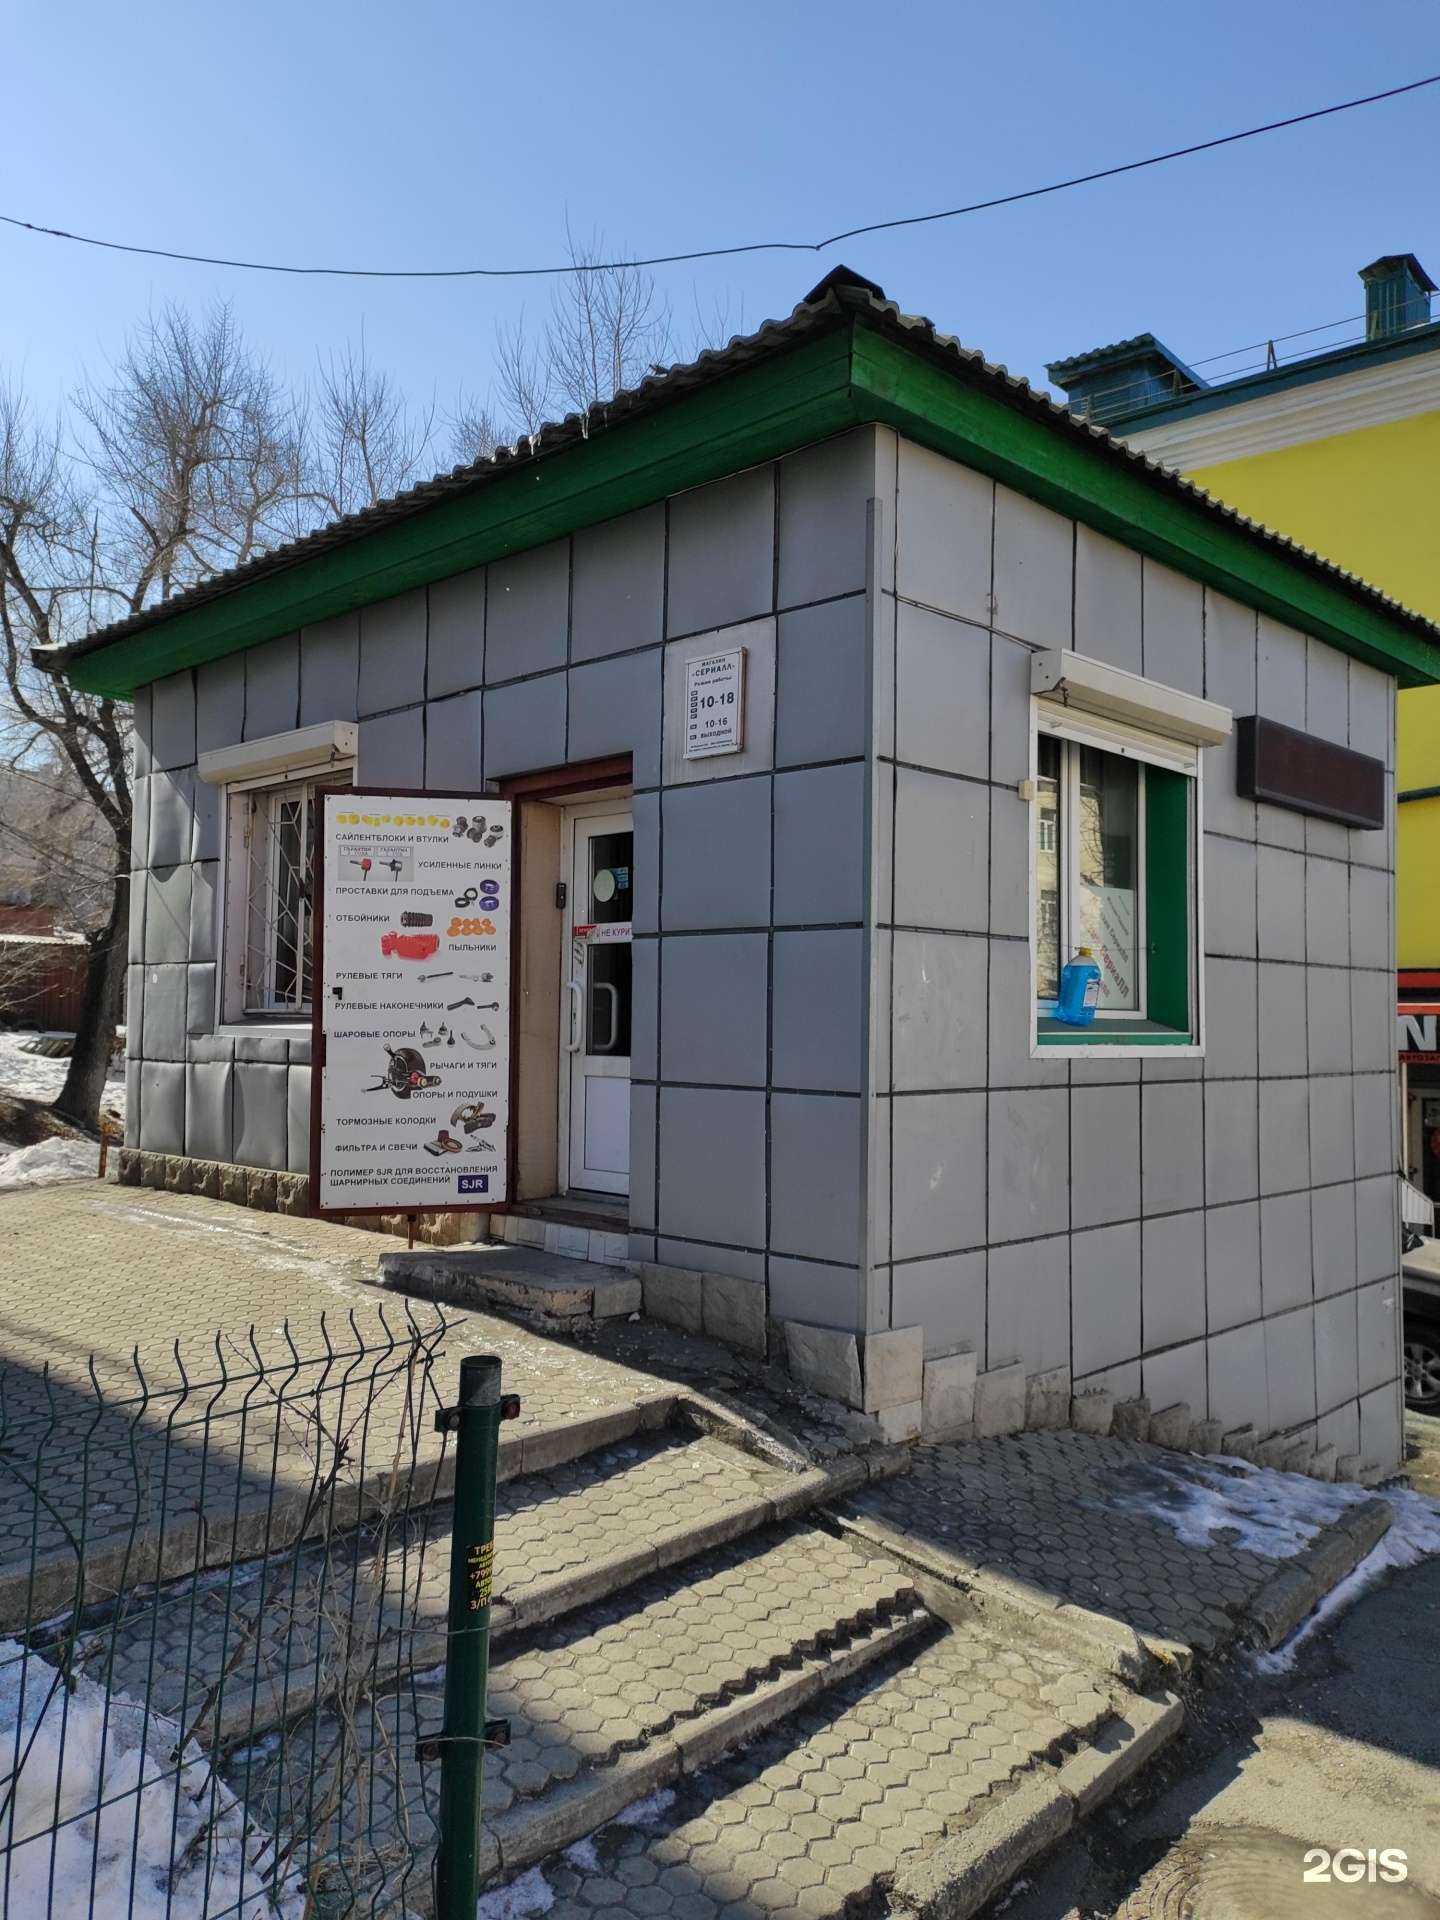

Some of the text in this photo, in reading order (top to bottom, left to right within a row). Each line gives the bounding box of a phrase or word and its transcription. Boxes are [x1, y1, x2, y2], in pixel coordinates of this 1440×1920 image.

[700, 692, 734, 709] 10-18
[336, 833, 406, 842] САЙЛЕНТБЛОКИ
[474, 863, 502, 871] ЛИНКИ
[336, 887, 388, 895] ПРОСТАВКИ
[390, 888, 408, 896] ДЛЯ
[336, 913, 390, 922] ОТБОЙНИКИ
[336, 972, 403, 980] РУЛЕВЫЕ ТЯГИ
[382, 1030, 416, 1038] ОПОРЫ
[429, 1062, 465, 1070] РЫЧАГИ
[456, 1091, 498, 1099] ПОДУШКИ
[336, 1117, 436, 1126] ТОРМОЗНЫЕ КОЛОДКИ
[335, 1144, 377, 1152] ФИЛЬТРА
[395, 1169, 413, 1177] ДЛЯ
[415, 1165, 498, 1175] ВОССТАНОВЛЕНИЯ
[330, 1176, 450, 1187] ШАРНИРНЫХ СОЕДИНЕНИЙ
[461, 1180, 484, 1189] SJR
